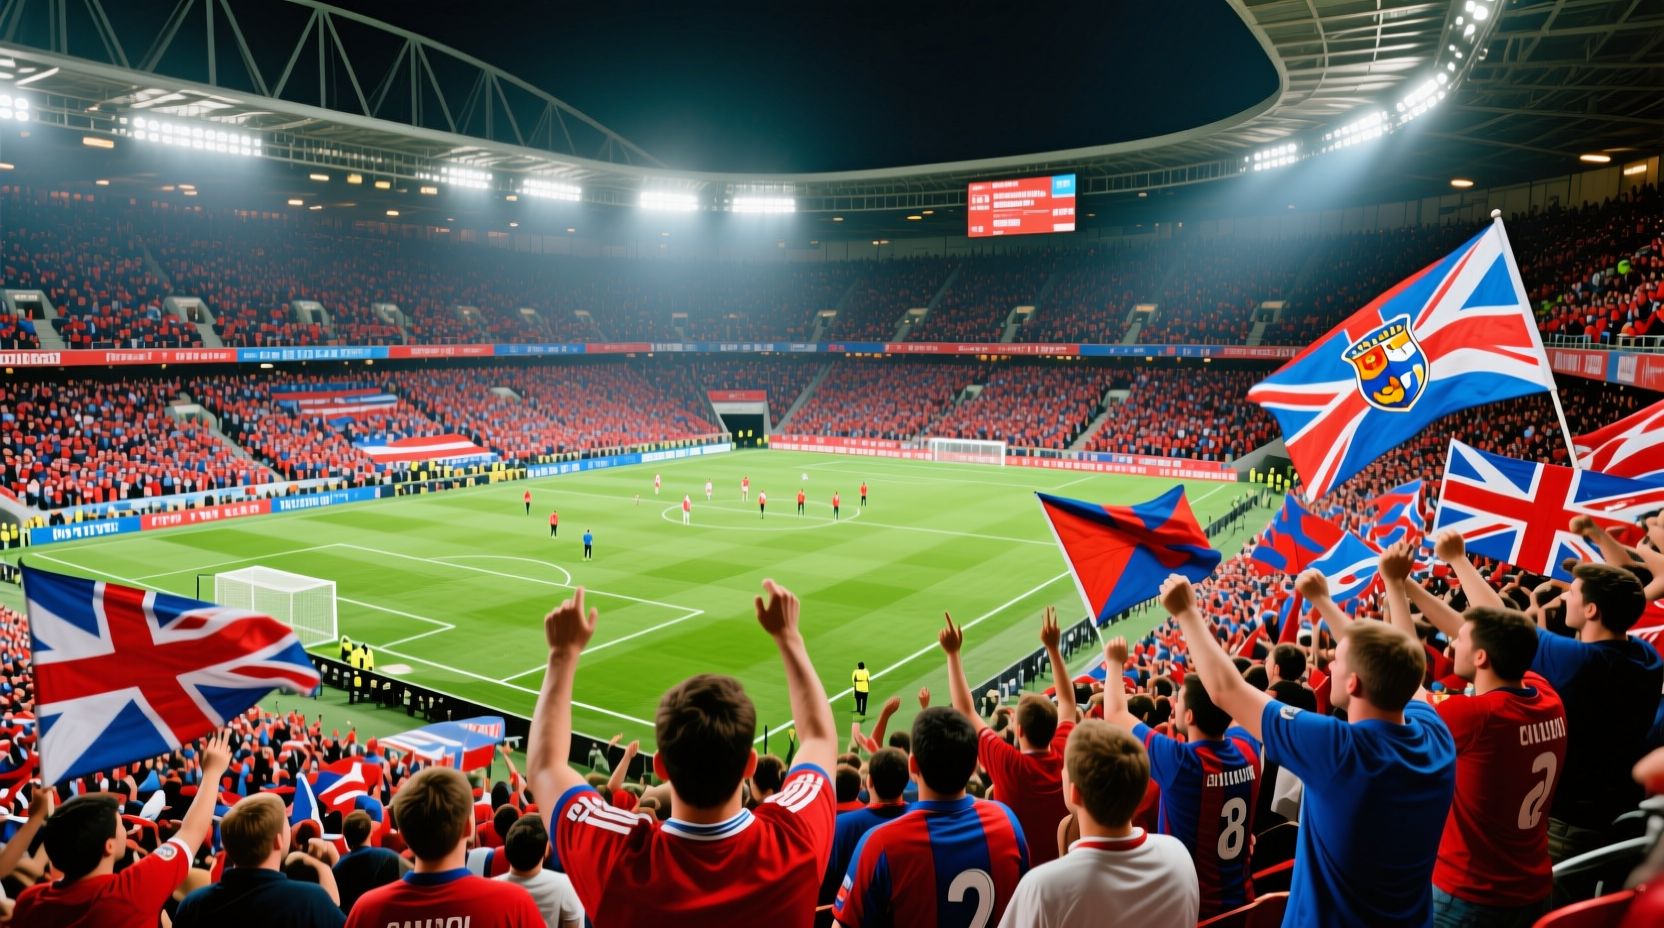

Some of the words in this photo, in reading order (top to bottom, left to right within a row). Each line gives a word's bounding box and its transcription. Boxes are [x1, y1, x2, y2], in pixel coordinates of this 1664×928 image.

[1518, 751, 1557, 829] 2
[1217, 797, 1247, 860] 8
[948, 868, 995, 928] 2
